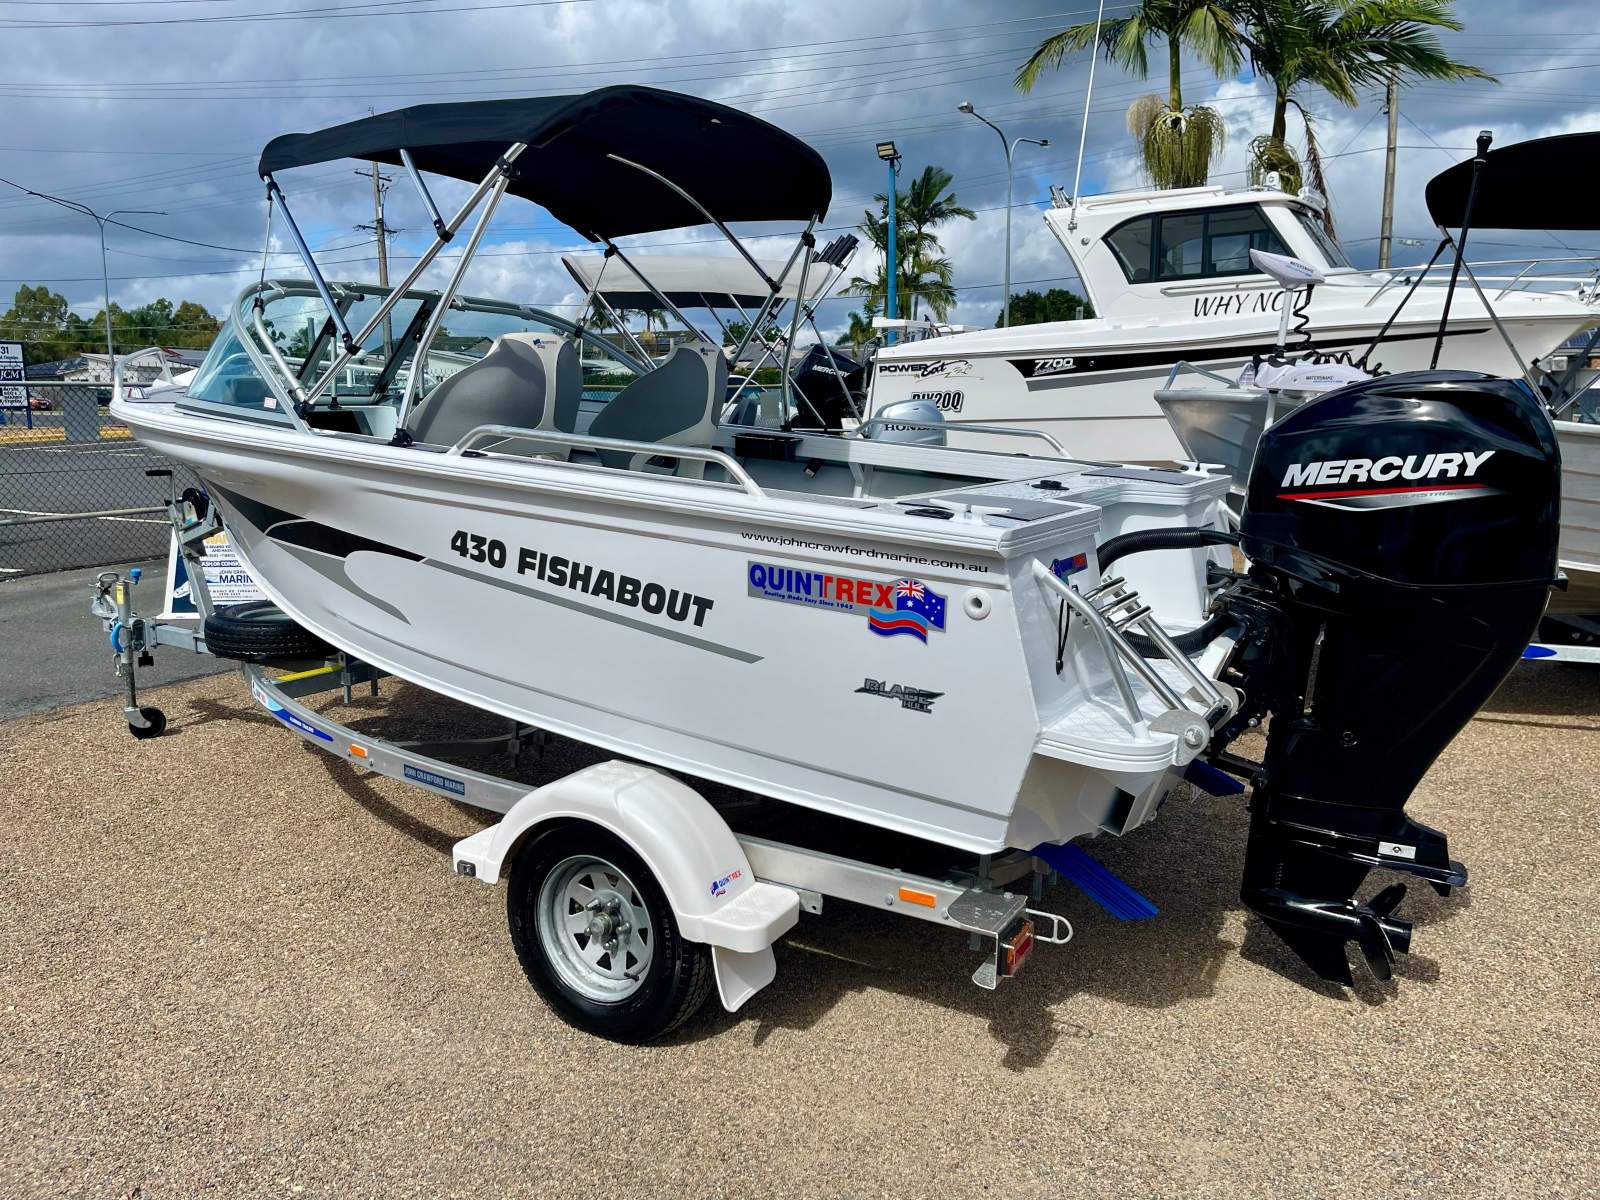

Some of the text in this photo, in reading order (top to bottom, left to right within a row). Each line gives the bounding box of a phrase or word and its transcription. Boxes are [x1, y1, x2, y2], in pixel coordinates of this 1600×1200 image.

[1194, 294, 1250, 317] WHY
[884, 423, 938, 432] HON
[1280, 450, 1496, 488] MERCURY
[741, 532, 989, 574] www.johncrawfordmarine.com.au
[219, 574, 254, 584] MARIN
[450, 529, 714, 628] 430 FISHABOUT
[750, 564, 894, 609] QUINTREX
[764, 590, 786, 600] Boating
[787, 593, 803, 602] Made
[804, 597, 818, 605] Easy
[819, 599, 834, 607] Since
[857, 678, 942, 705] BLADE
[902, 700, 932, 714] HULL
